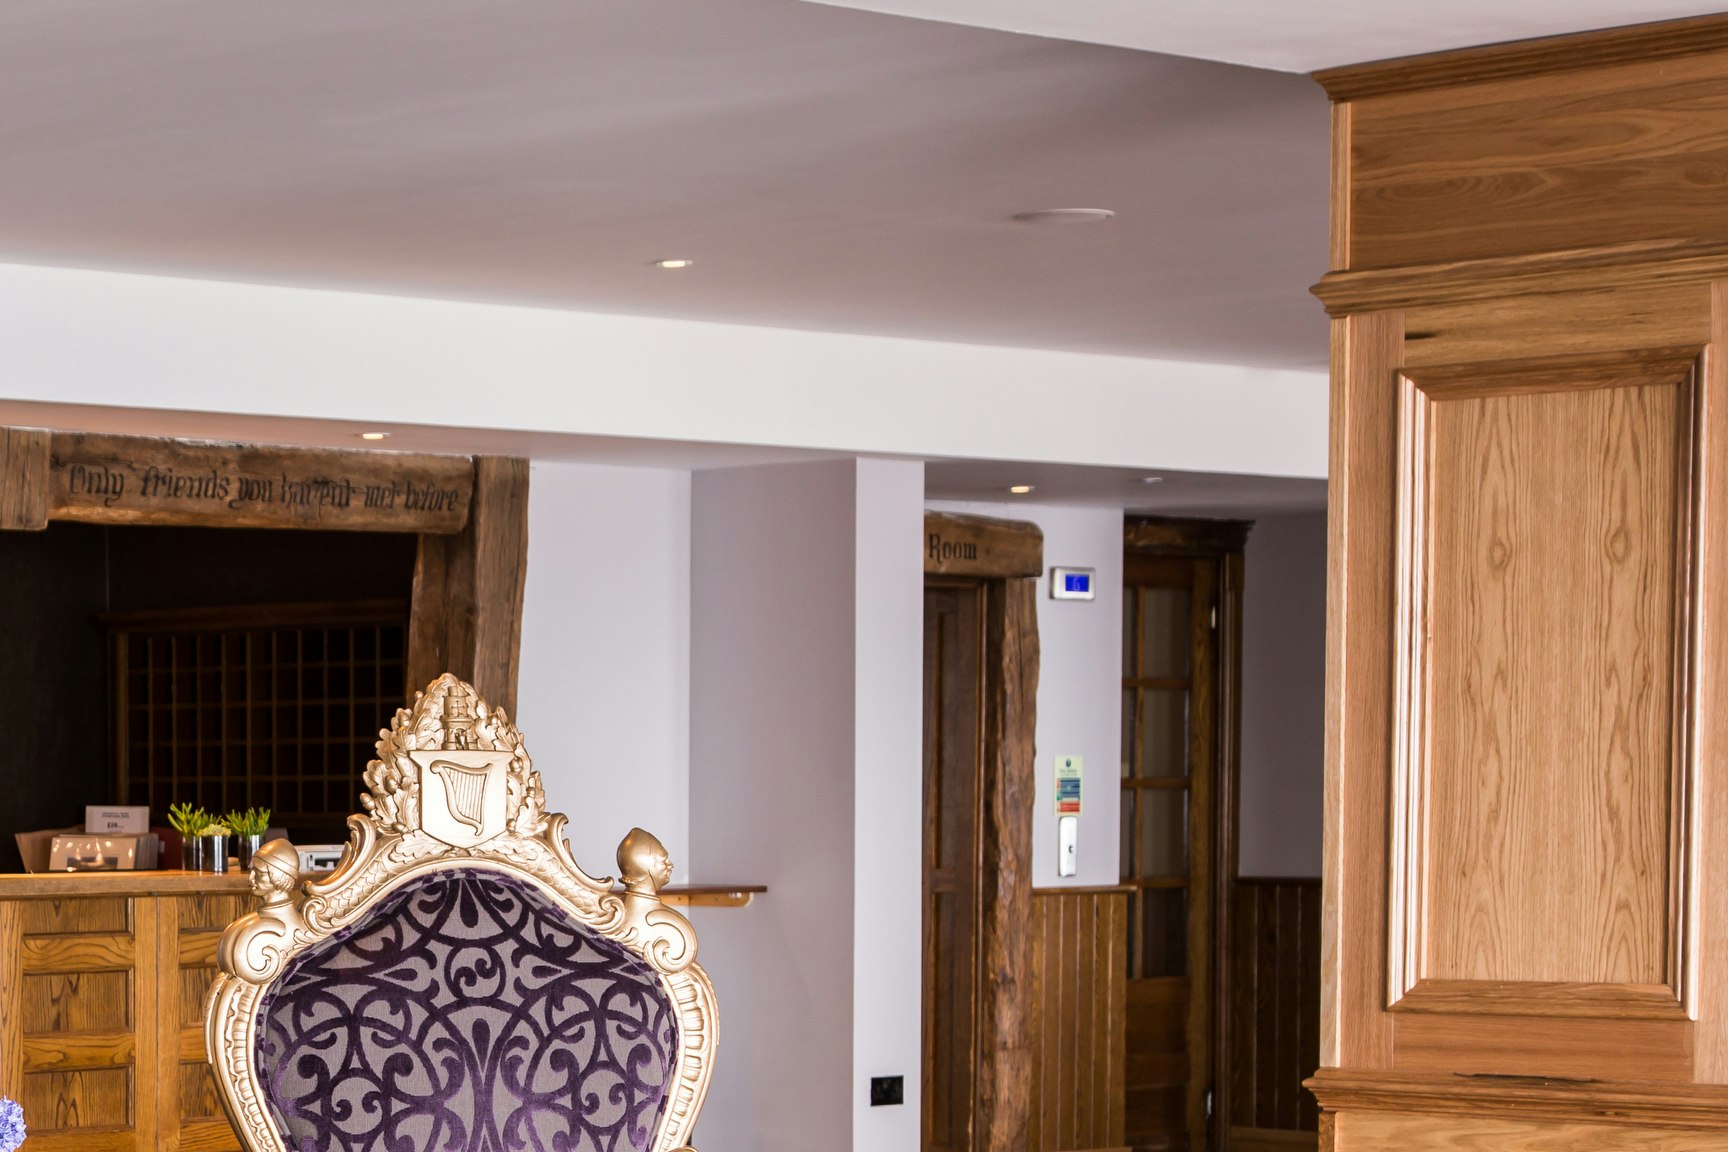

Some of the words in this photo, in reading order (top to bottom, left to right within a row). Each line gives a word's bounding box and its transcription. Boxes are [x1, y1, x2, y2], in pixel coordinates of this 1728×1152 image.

[69, 463, 125, 507] Only
[140, 465, 231, 500] friends
[227, 474, 273, 509] you
[404, 479, 460, 512] before
[928, 532, 977, 564] Room
